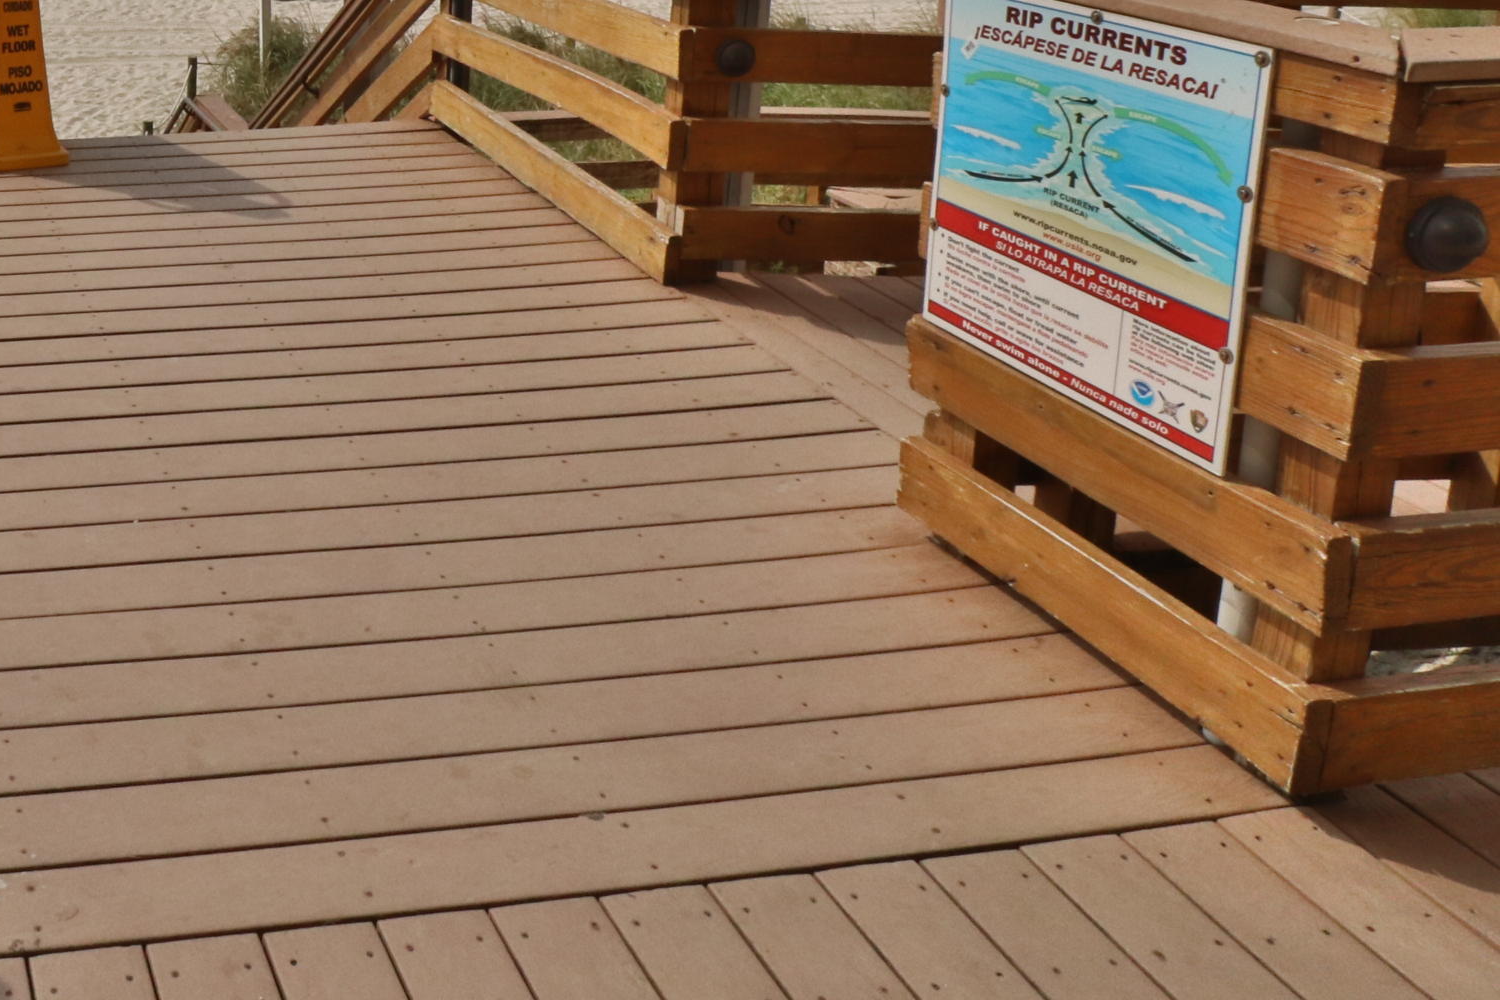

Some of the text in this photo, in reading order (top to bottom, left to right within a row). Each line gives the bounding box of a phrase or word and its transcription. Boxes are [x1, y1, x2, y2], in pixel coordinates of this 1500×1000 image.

[2, 40, 36, 54] FLOOR
[7, 24, 29, 37] WET
[1005, 5, 1187, 66] RIP CURRENTS
[0, 81, 43, 96] MOJADO
[8, 66, 32, 78] PISO
[1071, 46, 1096, 68] DE
[1100, 54, 1123, 75] LA
[1128, 61, 1218, 100] RESACA!
[1059, 193, 1099, 213] CURRENT
[978, 221, 1166, 310] IF CAUGHT IN A RIP CURRENT
[1013, 209, 1137, 268] www.ripcurrents.noaa.gov
[995, 239, 1139, 312] SI LO ATRAPA LA RESACA
[962, 320, 993, 344] Never
[995, 337, 1024, 360] swim
[1027, 354, 1060, 379] alone
[1070, 376, 1106, 403] Nunca
[1108, 396, 1138, 420] nade
[1141, 413, 1169, 436] solo
